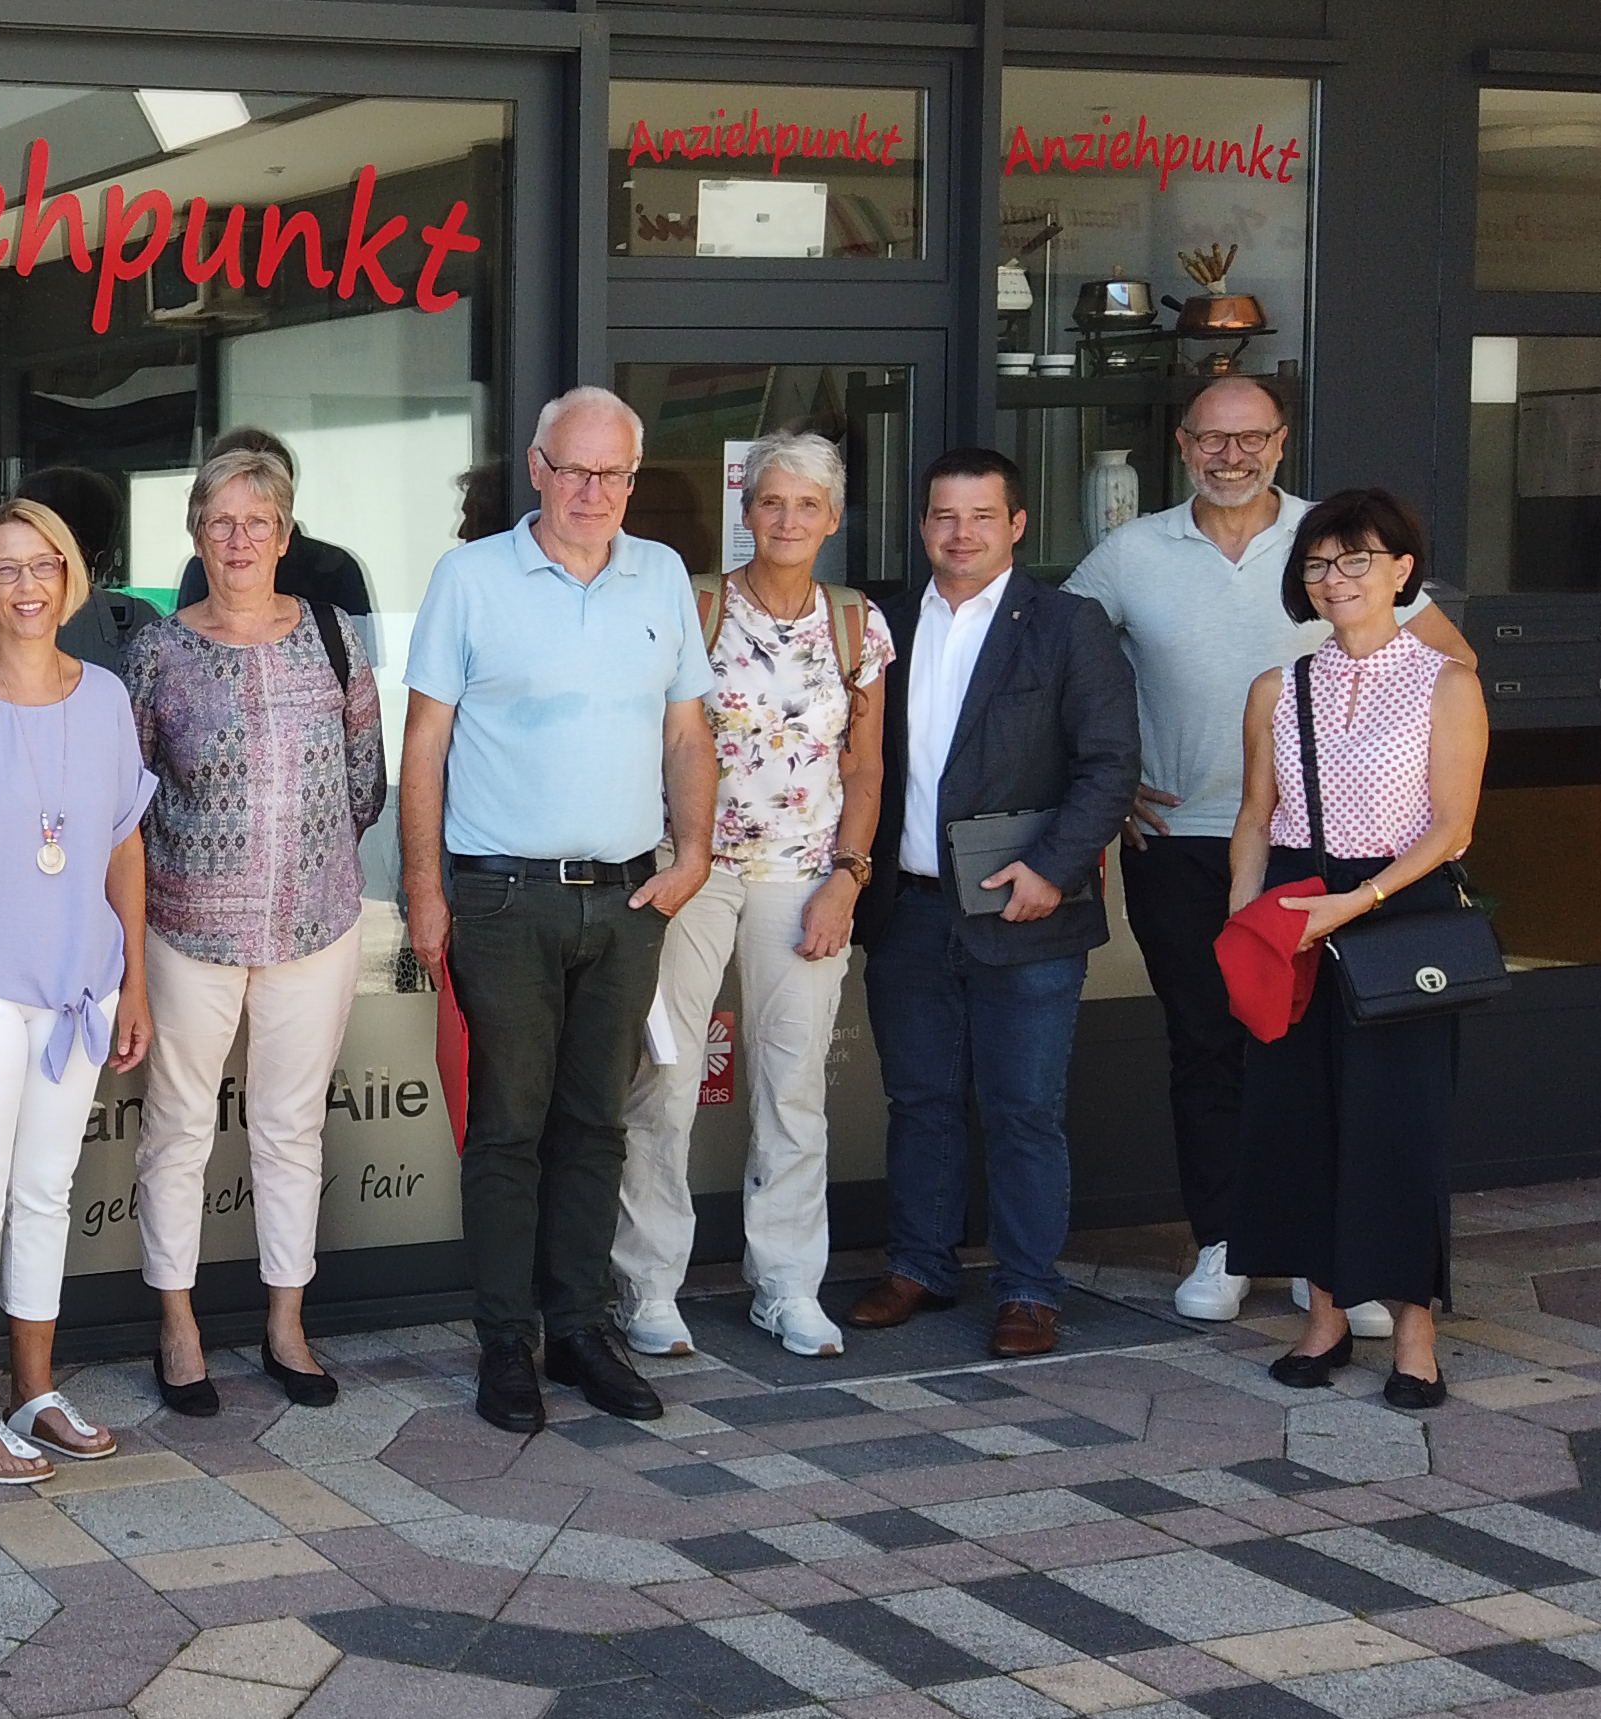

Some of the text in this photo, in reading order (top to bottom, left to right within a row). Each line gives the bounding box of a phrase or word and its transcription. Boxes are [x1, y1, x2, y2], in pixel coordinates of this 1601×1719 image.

[628, 108, 904, 176] Anziehpunkt
[1004, 116, 1301, 192] Anziehpunkt
[699, 1085, 730, 1103] itas
[360, 1163, 425, 1203] fair
